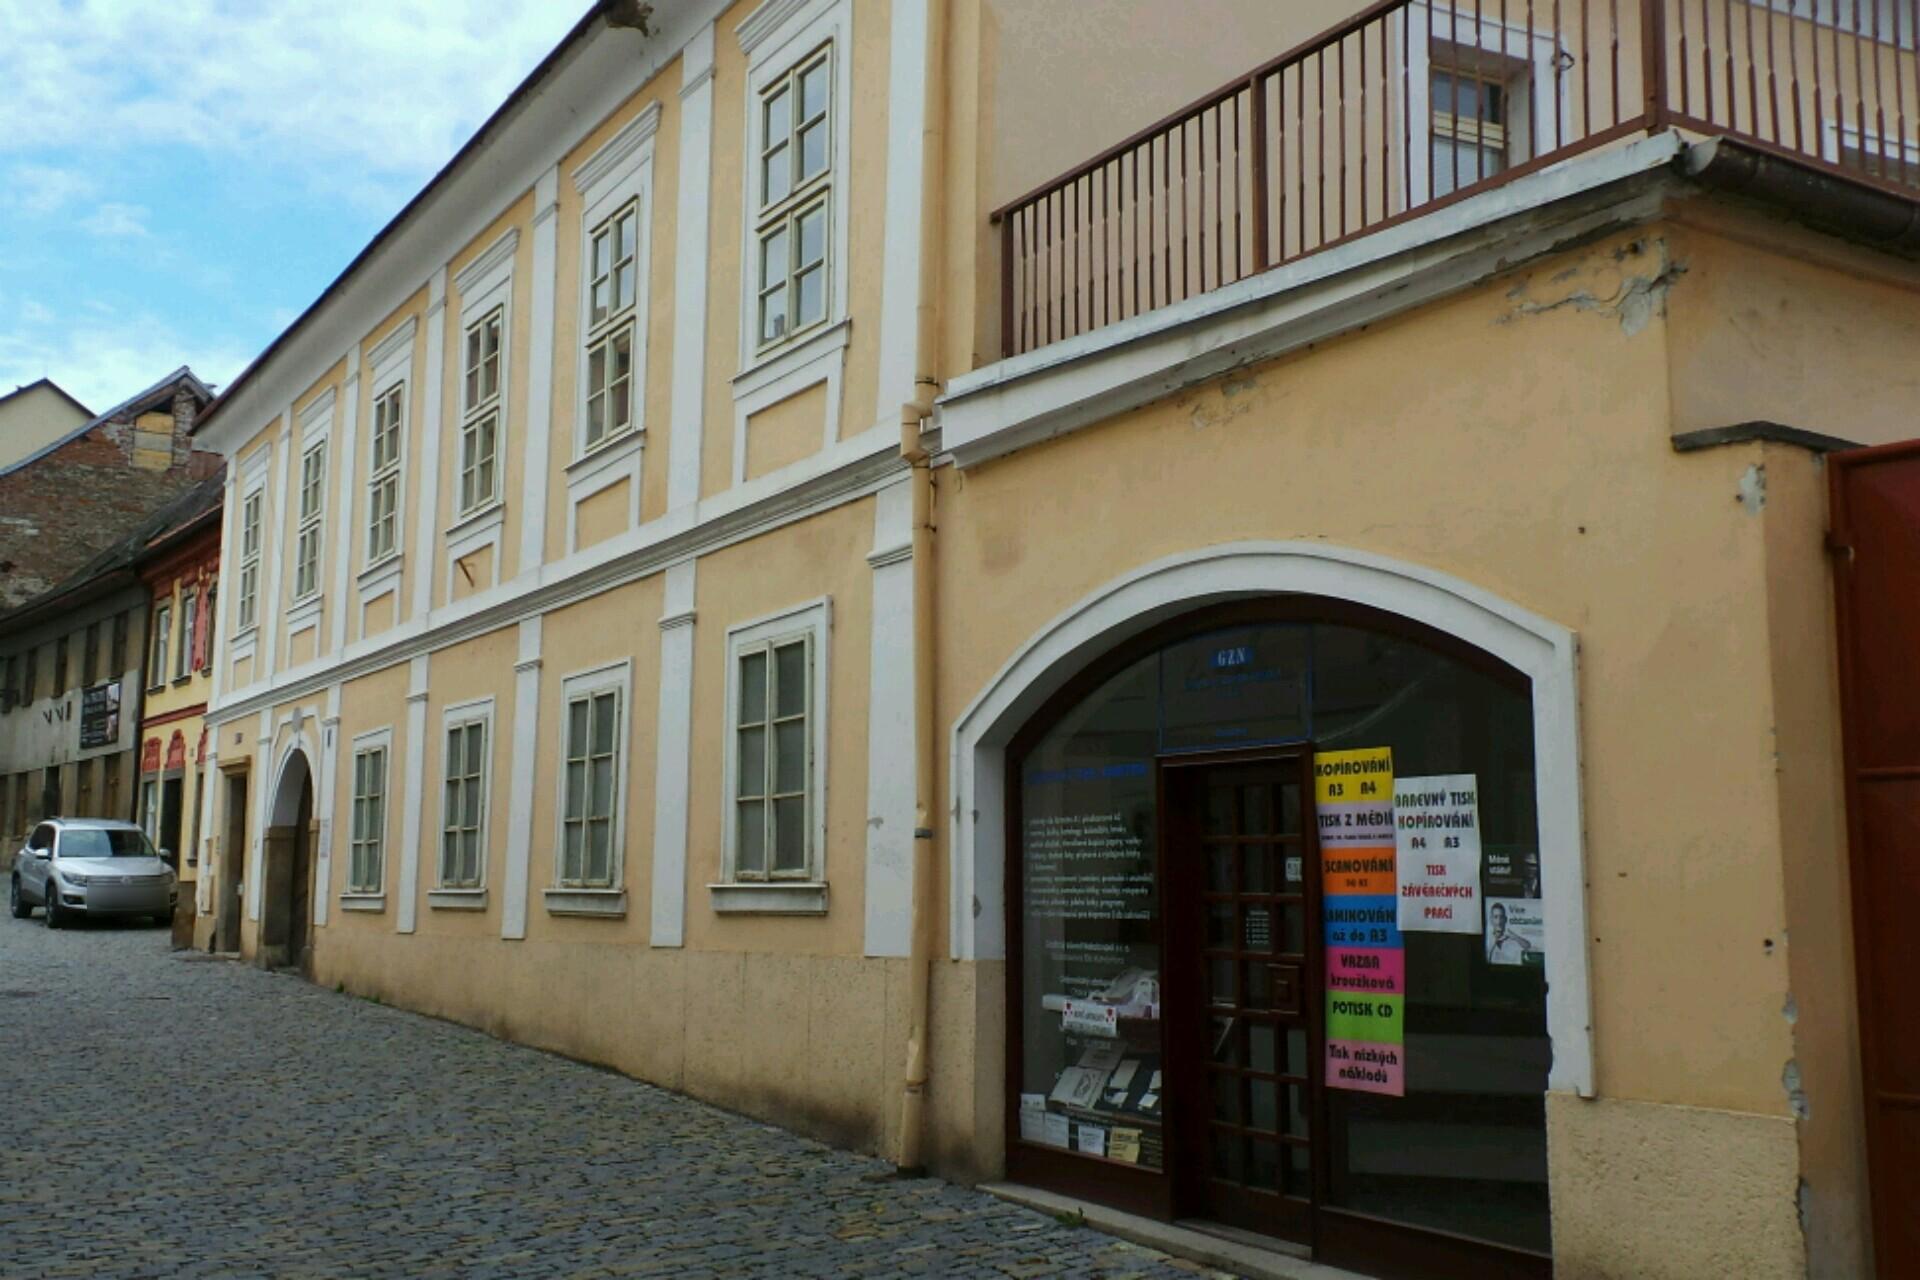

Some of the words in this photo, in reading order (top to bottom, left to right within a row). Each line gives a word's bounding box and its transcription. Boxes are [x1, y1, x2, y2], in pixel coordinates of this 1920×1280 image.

[1315, 756, 1391, 777] KOPÍROVÁNÍ
[1328, 783, 1344, 797] A3
[1360, 781, 1376, 795] A4
[1394, 788, 1446, 808] BAREVNÝ
[1449, 791, 1475, 807] TISK
[1319, 812, 1342, 828] TISK
[1345, 813, 1352, 826] Z
[1398, 810, 1474, 829] KOPÍROVÁNÍ
[1411, 836, 1427, 849] A4
[1444, 836, 1460, 849] A3
[1426, 864, 1447, 876] TISK
[1332, 1001, 1373, 1017] POTISK
[1377, 1002, 1393, 1018] CD
